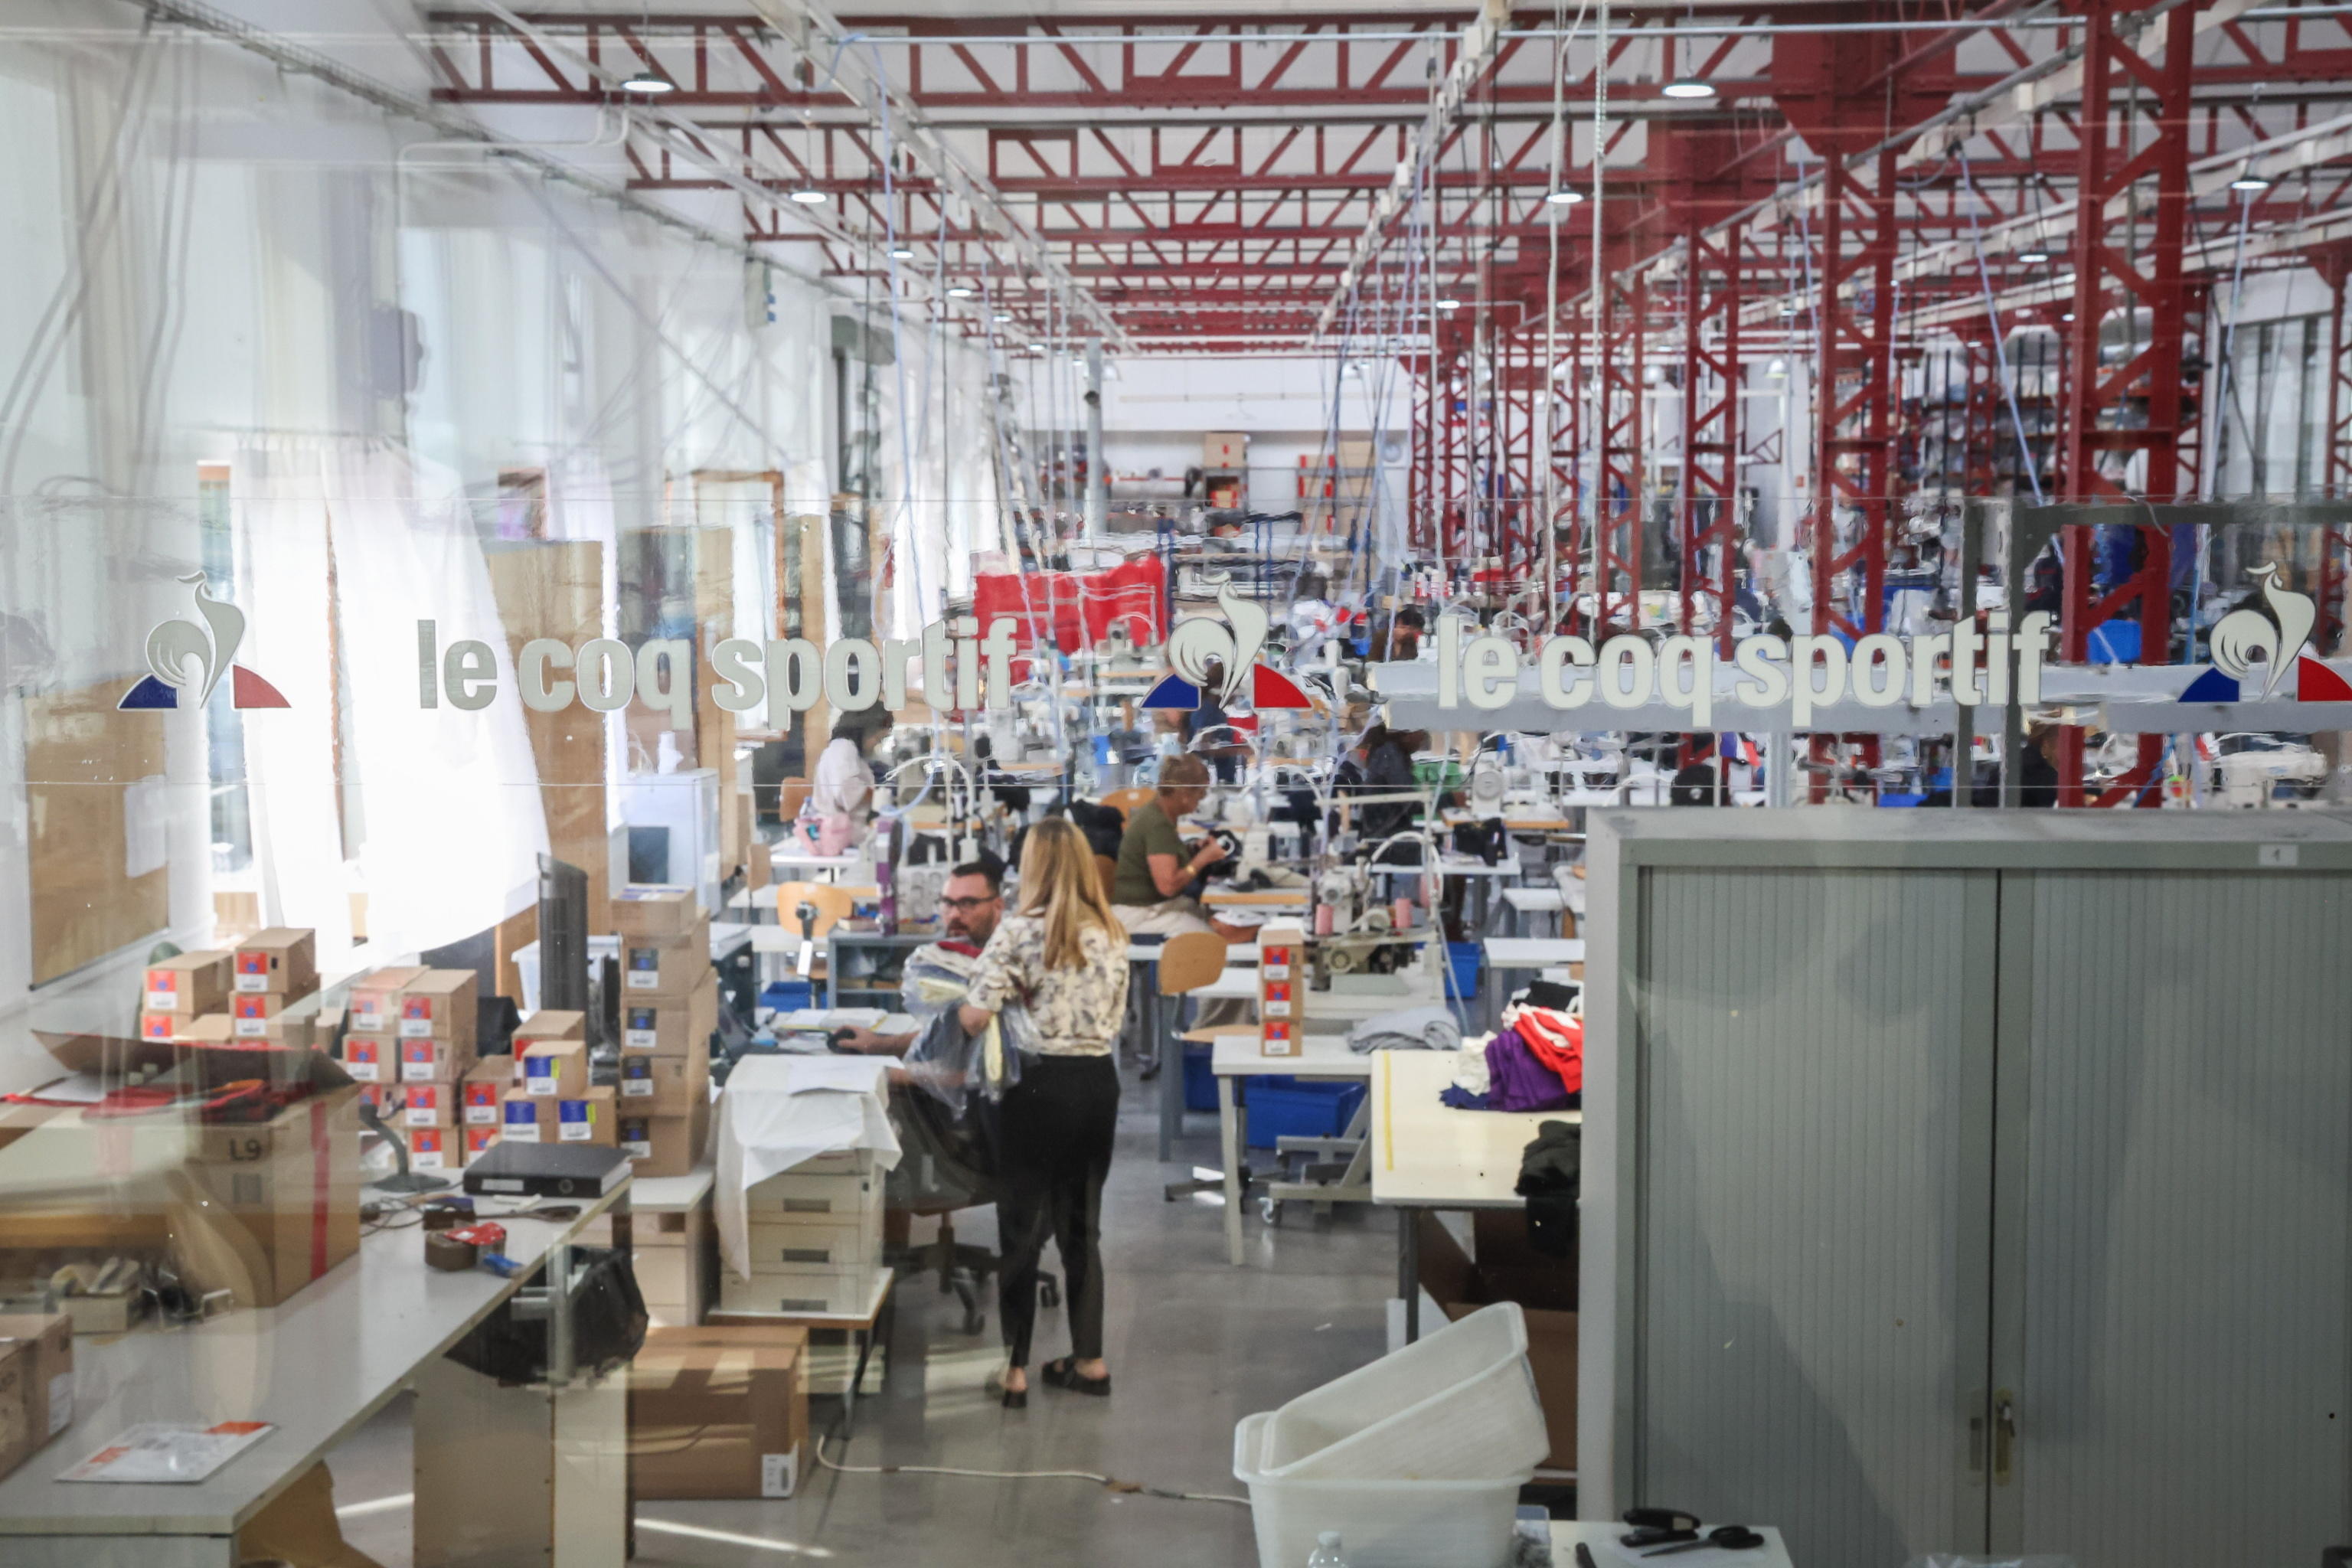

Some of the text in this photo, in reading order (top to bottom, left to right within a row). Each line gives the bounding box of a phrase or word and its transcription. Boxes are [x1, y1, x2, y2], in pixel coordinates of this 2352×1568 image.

[417, 615, 1018, 730] le coq sportif
[1438, 610, 2051, 727] le coq sportif
